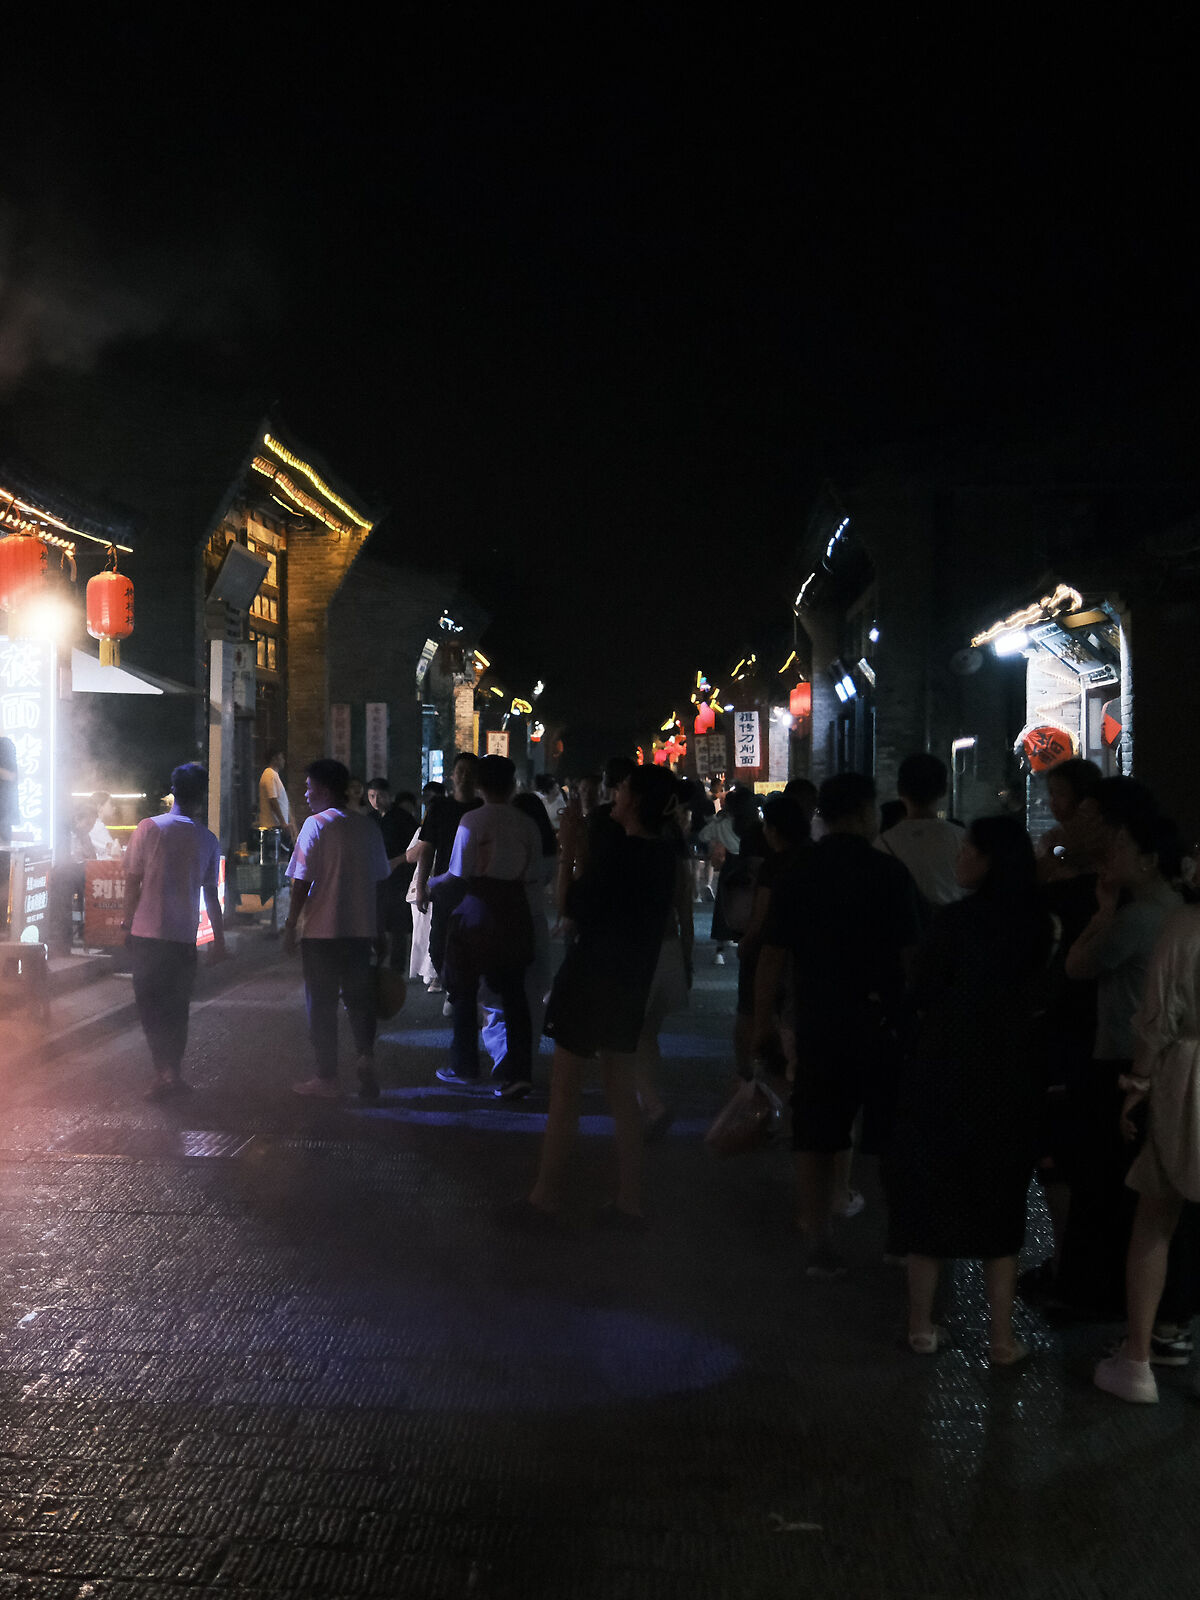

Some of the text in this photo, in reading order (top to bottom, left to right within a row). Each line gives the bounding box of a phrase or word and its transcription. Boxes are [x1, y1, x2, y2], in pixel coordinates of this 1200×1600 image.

[738, 712, 757, 765] 祖传刀削面
